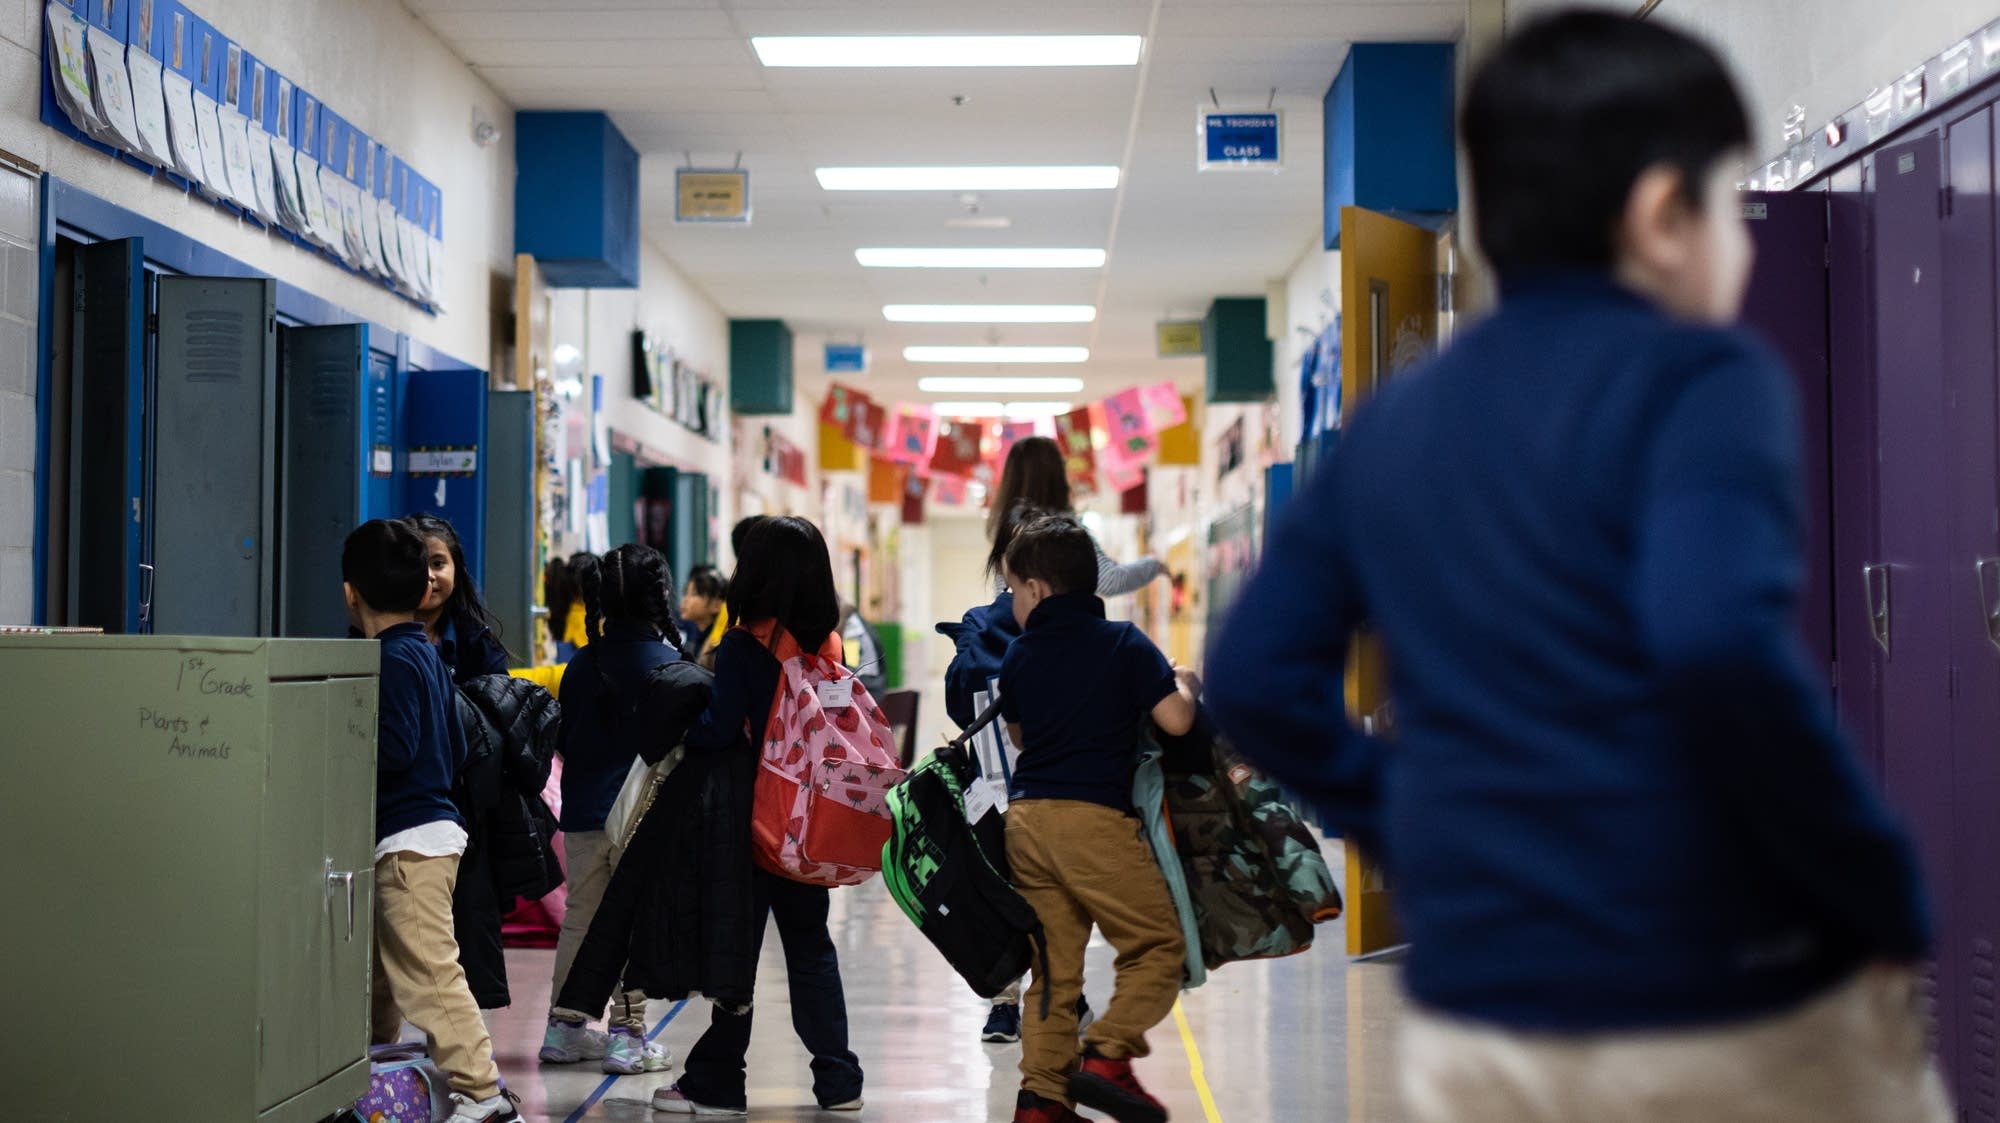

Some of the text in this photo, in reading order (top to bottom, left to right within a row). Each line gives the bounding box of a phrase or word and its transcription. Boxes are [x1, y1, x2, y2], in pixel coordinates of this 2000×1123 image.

[1223, 146, 1261, 156] CLASS
[176, 657, 255, 698] 1st Grade
[136, 706, 189, 735] Plants
[167, 735, 231, 760] Animals
